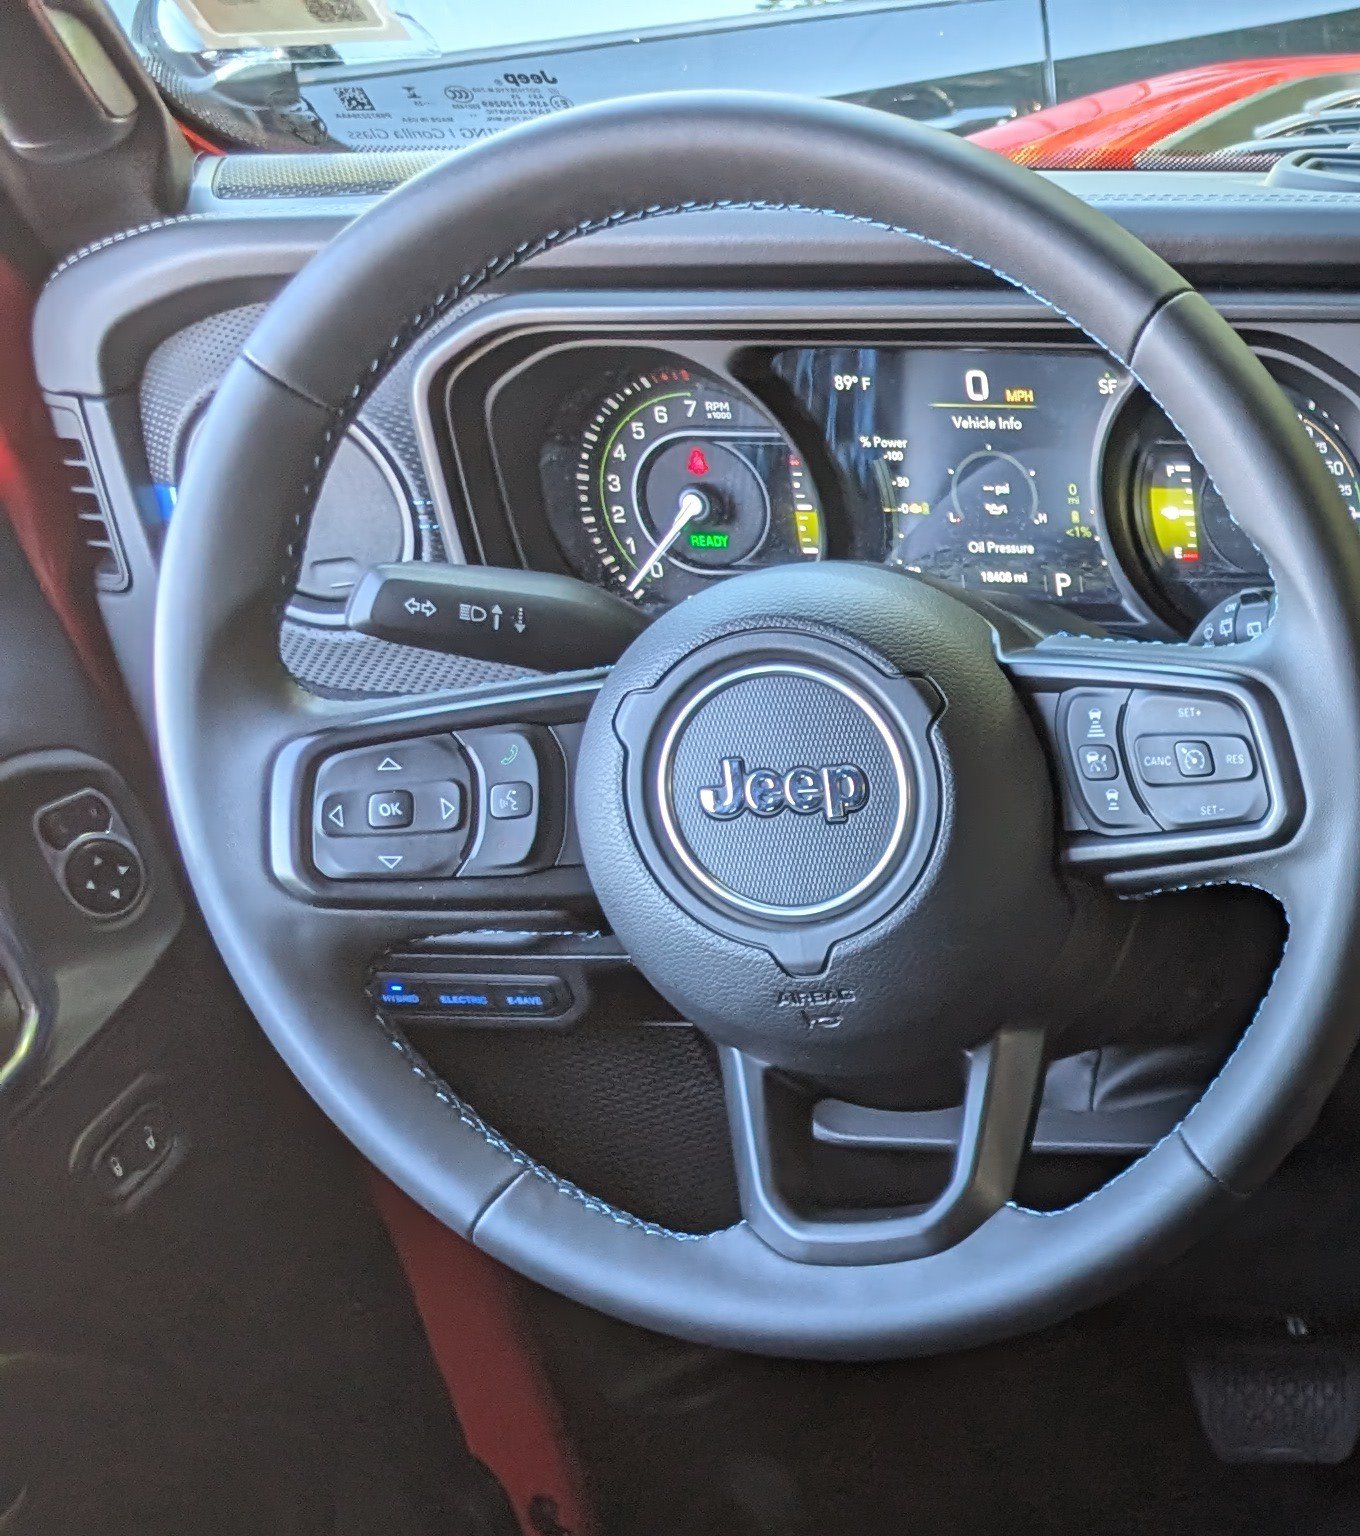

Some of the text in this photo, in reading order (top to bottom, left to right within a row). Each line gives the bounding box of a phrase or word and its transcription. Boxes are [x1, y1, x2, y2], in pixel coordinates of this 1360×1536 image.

[965, 369, 1034, 403] 0 MPH
[654, 406, 668, 424] 6
[684, 400, 730, 418] 7 RPM
[631, 422, 646, 440] 5
[952, 416, 1023, 431] Vehicle Info
[873, 436, 908, 448] Power
[613, 443, 627, 462] 4
[608, 474, 621, 492] 3
[612, 506, 626, 524] 2
[690, 535, 730, 548] READY
[968, 541, 1035, 554] Oil Pressure
[1055, 573, 1072, 597] P
[1144, 754, 1245, 768] CANC RES
[698, 756, 871, 825] Jeep
[378, 802, 403, 818] OK
